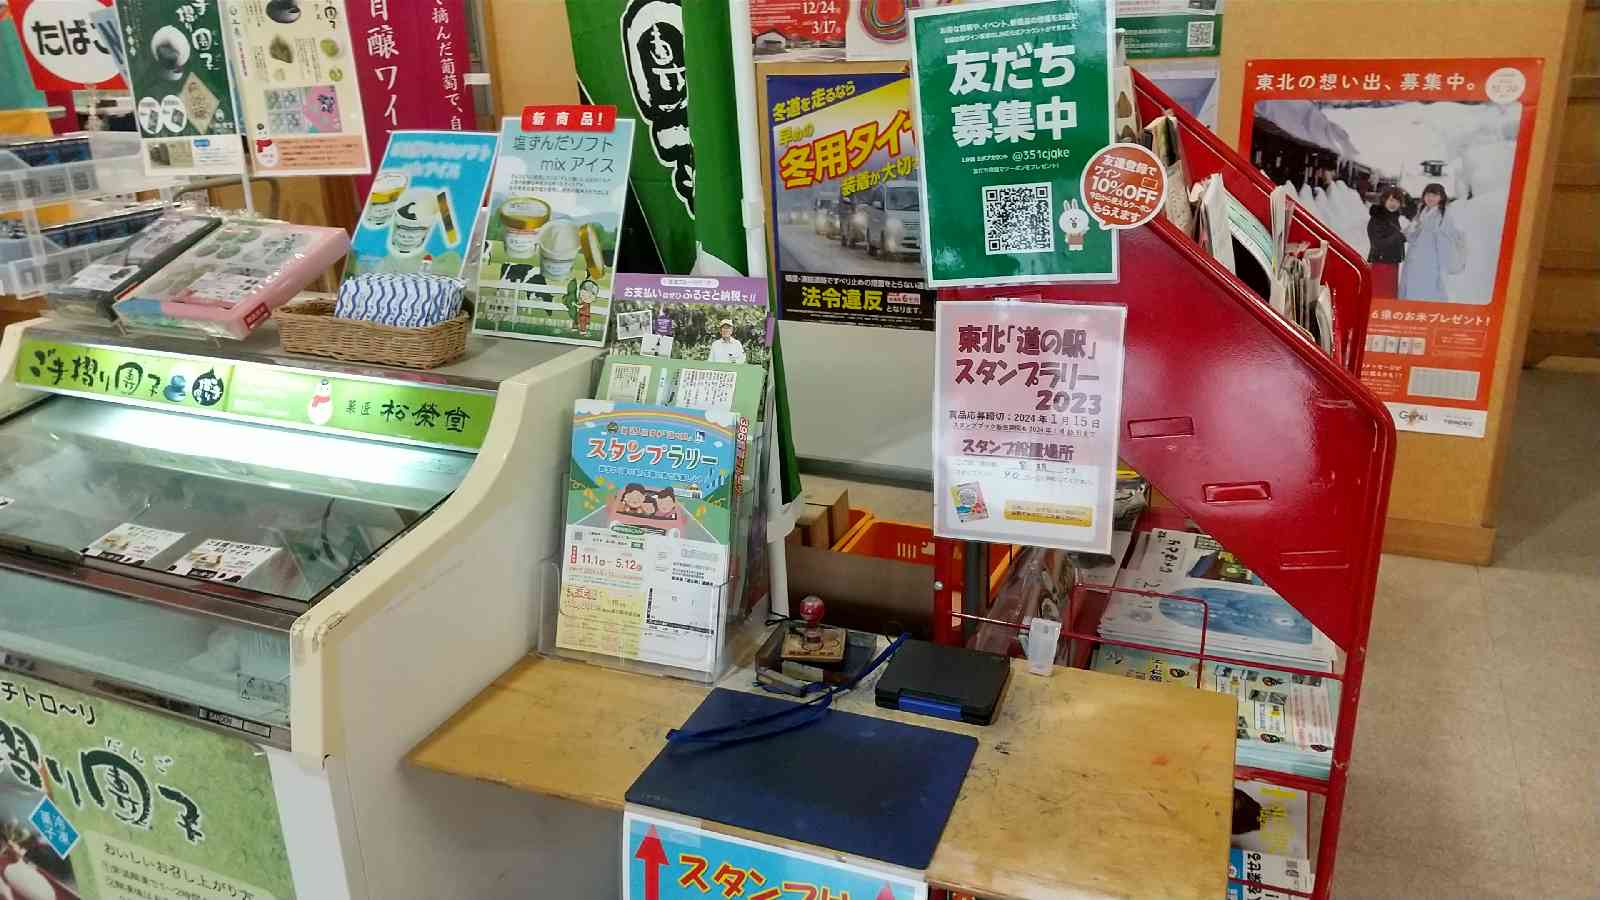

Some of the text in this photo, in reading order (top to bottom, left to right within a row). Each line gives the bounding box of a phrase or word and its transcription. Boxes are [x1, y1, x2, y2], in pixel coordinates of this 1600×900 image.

[803, 2, 834, 15] 12/24
[811, 20, 837, 34] 3/17
[946, 42, 1077, 97] 友だち
[1255, 71, 1478, 93] 東北の想い出、募集中。
[772, 80, 857, 123] 冬道を走るなら
[951, 96, 1079, 148] 募集中
[513, 135, 615, 153] 塩ずんだソフト
[540, 157, 616, 174] mix アイス
[1094, 165, 1121, 179] ワイン
[1091, 175, 1159, 204] 10%OFF
[801, 286, 883, 312] 法令違反
[957, 324, 1098, 361] 東北「道の駅」
[954, 358, 1101, 391] スタンプラリー
[1034, 389, 1103, 415] 2023
[587, 437, 720, 470] スタンプラリー
